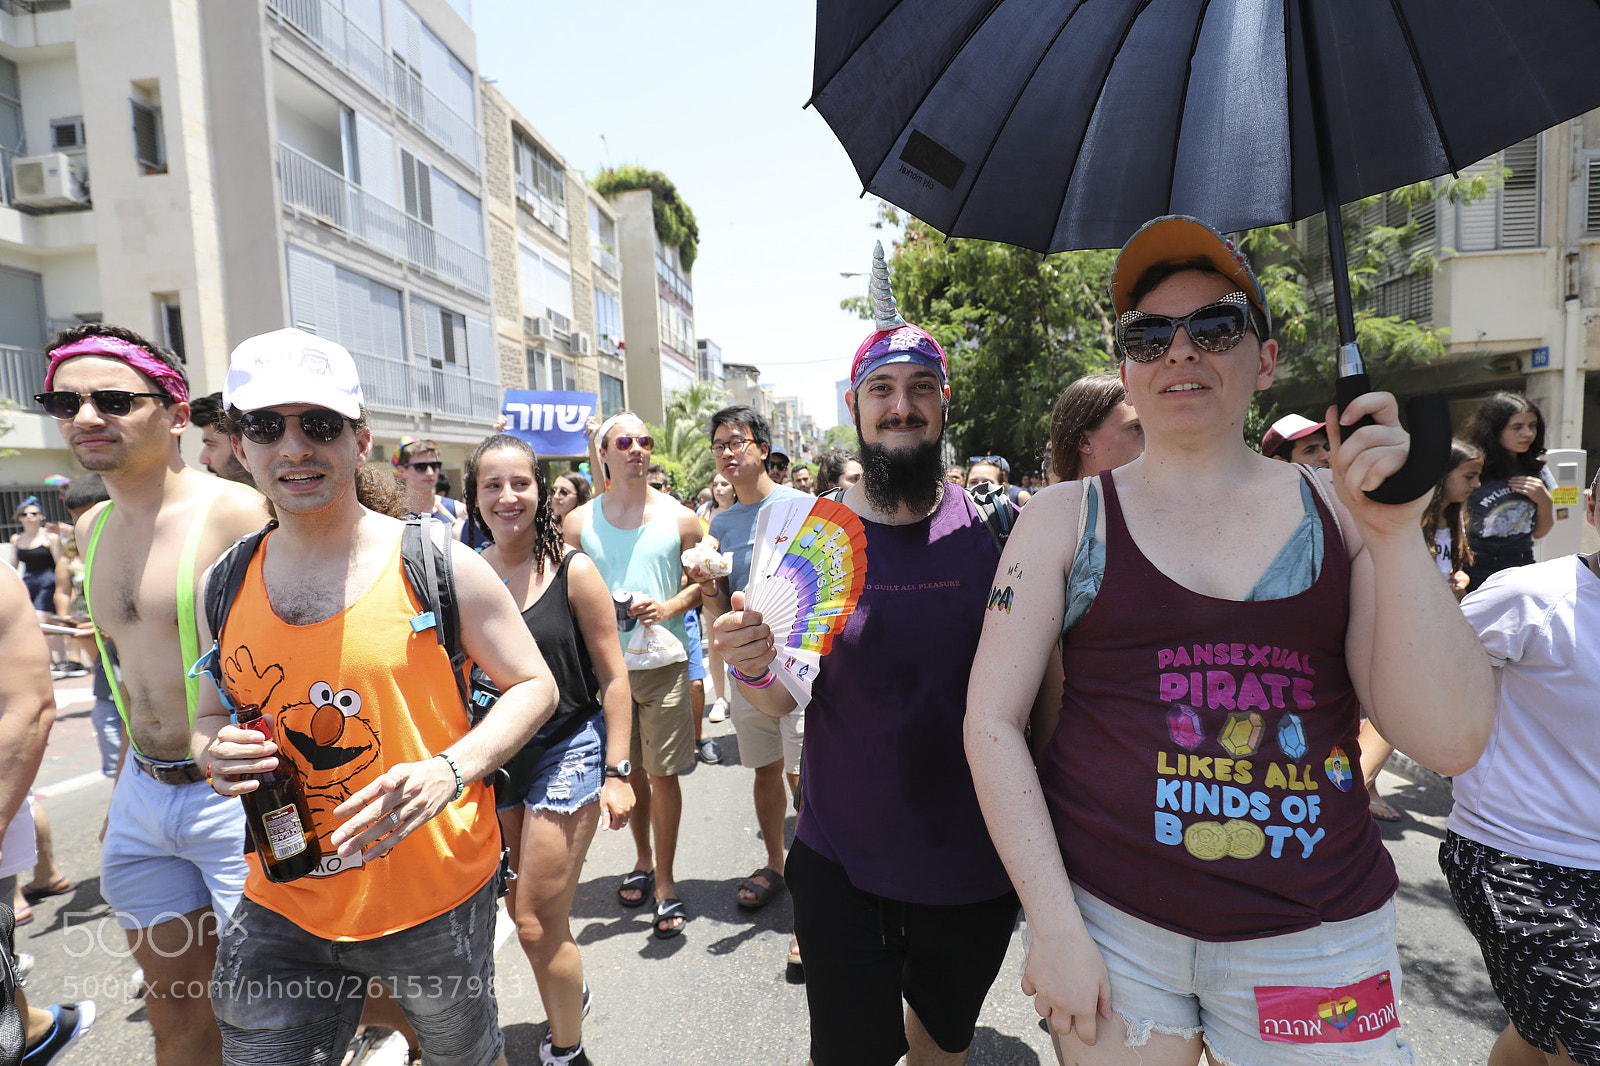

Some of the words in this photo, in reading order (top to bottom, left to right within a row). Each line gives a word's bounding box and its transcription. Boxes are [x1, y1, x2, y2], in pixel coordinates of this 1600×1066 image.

[505, 403, 592, 433] שווה
[918, 580, 961, 590] PLEASURE
[1157, 643, 1316, 675] PANSEXUAL
[1159, 670, 1317, 711] PIRATE
[1157, 751, 1253, 785] LIKES
[1264, 762, 1319, 791] ALL
[1155, 778, 1271, 821] KINDS
[1280, 794, 1321, 824] OF
[1263, 1018, 1323, 1037] אהבה
[1357, 1002, 1396, 1034] אהבה
